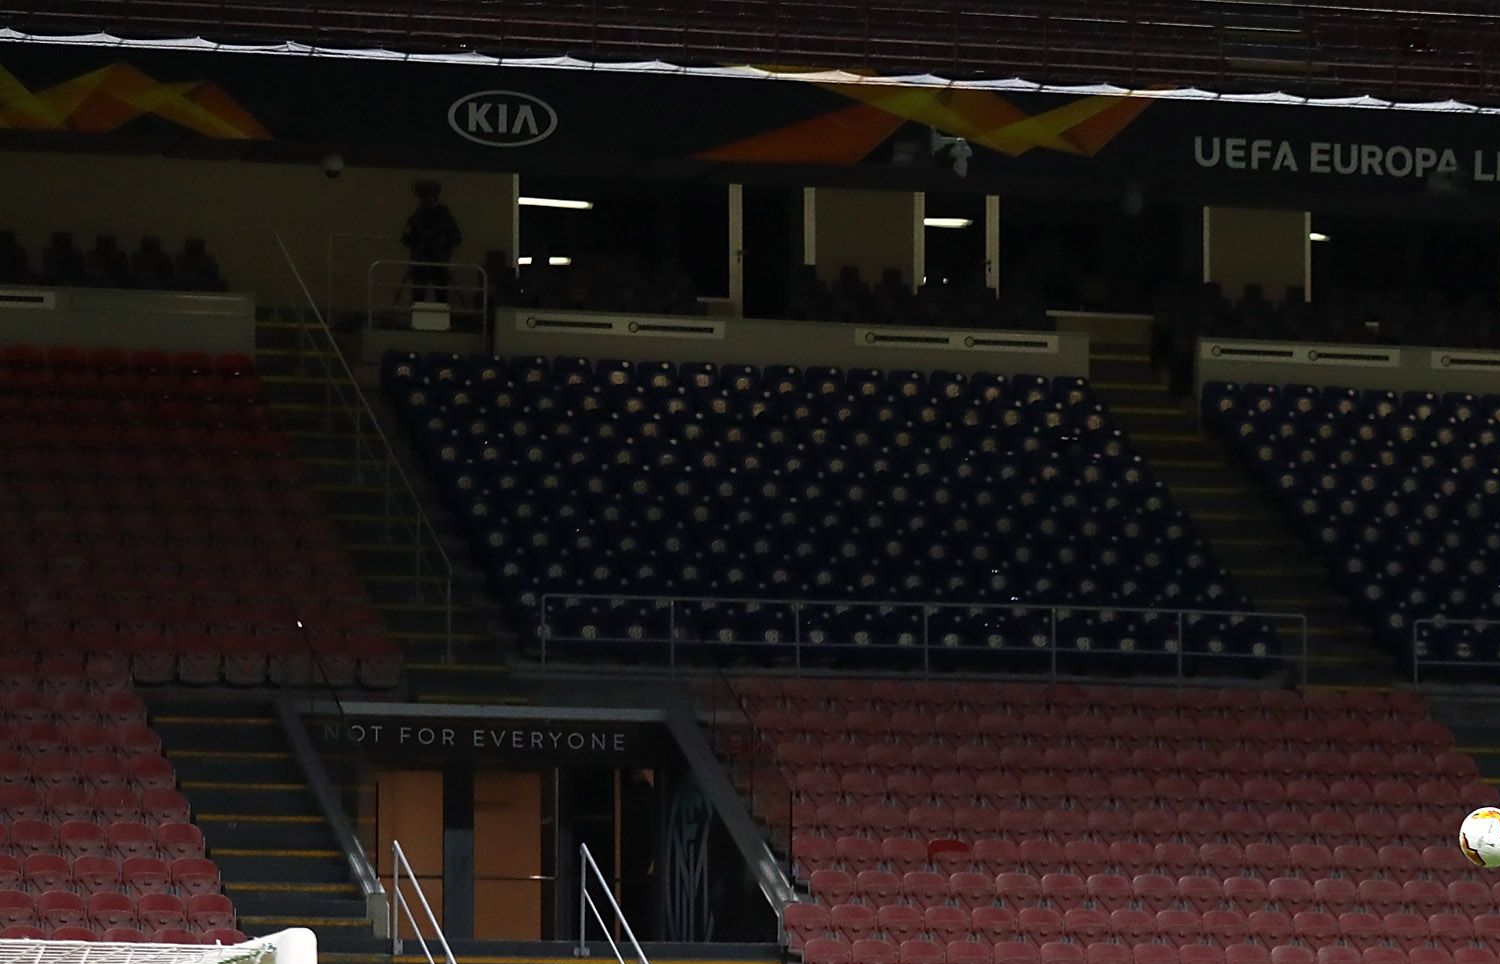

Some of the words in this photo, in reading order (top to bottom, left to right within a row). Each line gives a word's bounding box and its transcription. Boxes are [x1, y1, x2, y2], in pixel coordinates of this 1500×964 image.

[467, 102, 539, 135] KIA
[1194, 135, 1299, 172] UEFA
[1310, 142, 1458, 178] EUROPA
[323, 724, 383, 743] NOT
[399, 726, 455, 746] FOR
[473, 729, 626, 751] EVERYONE
